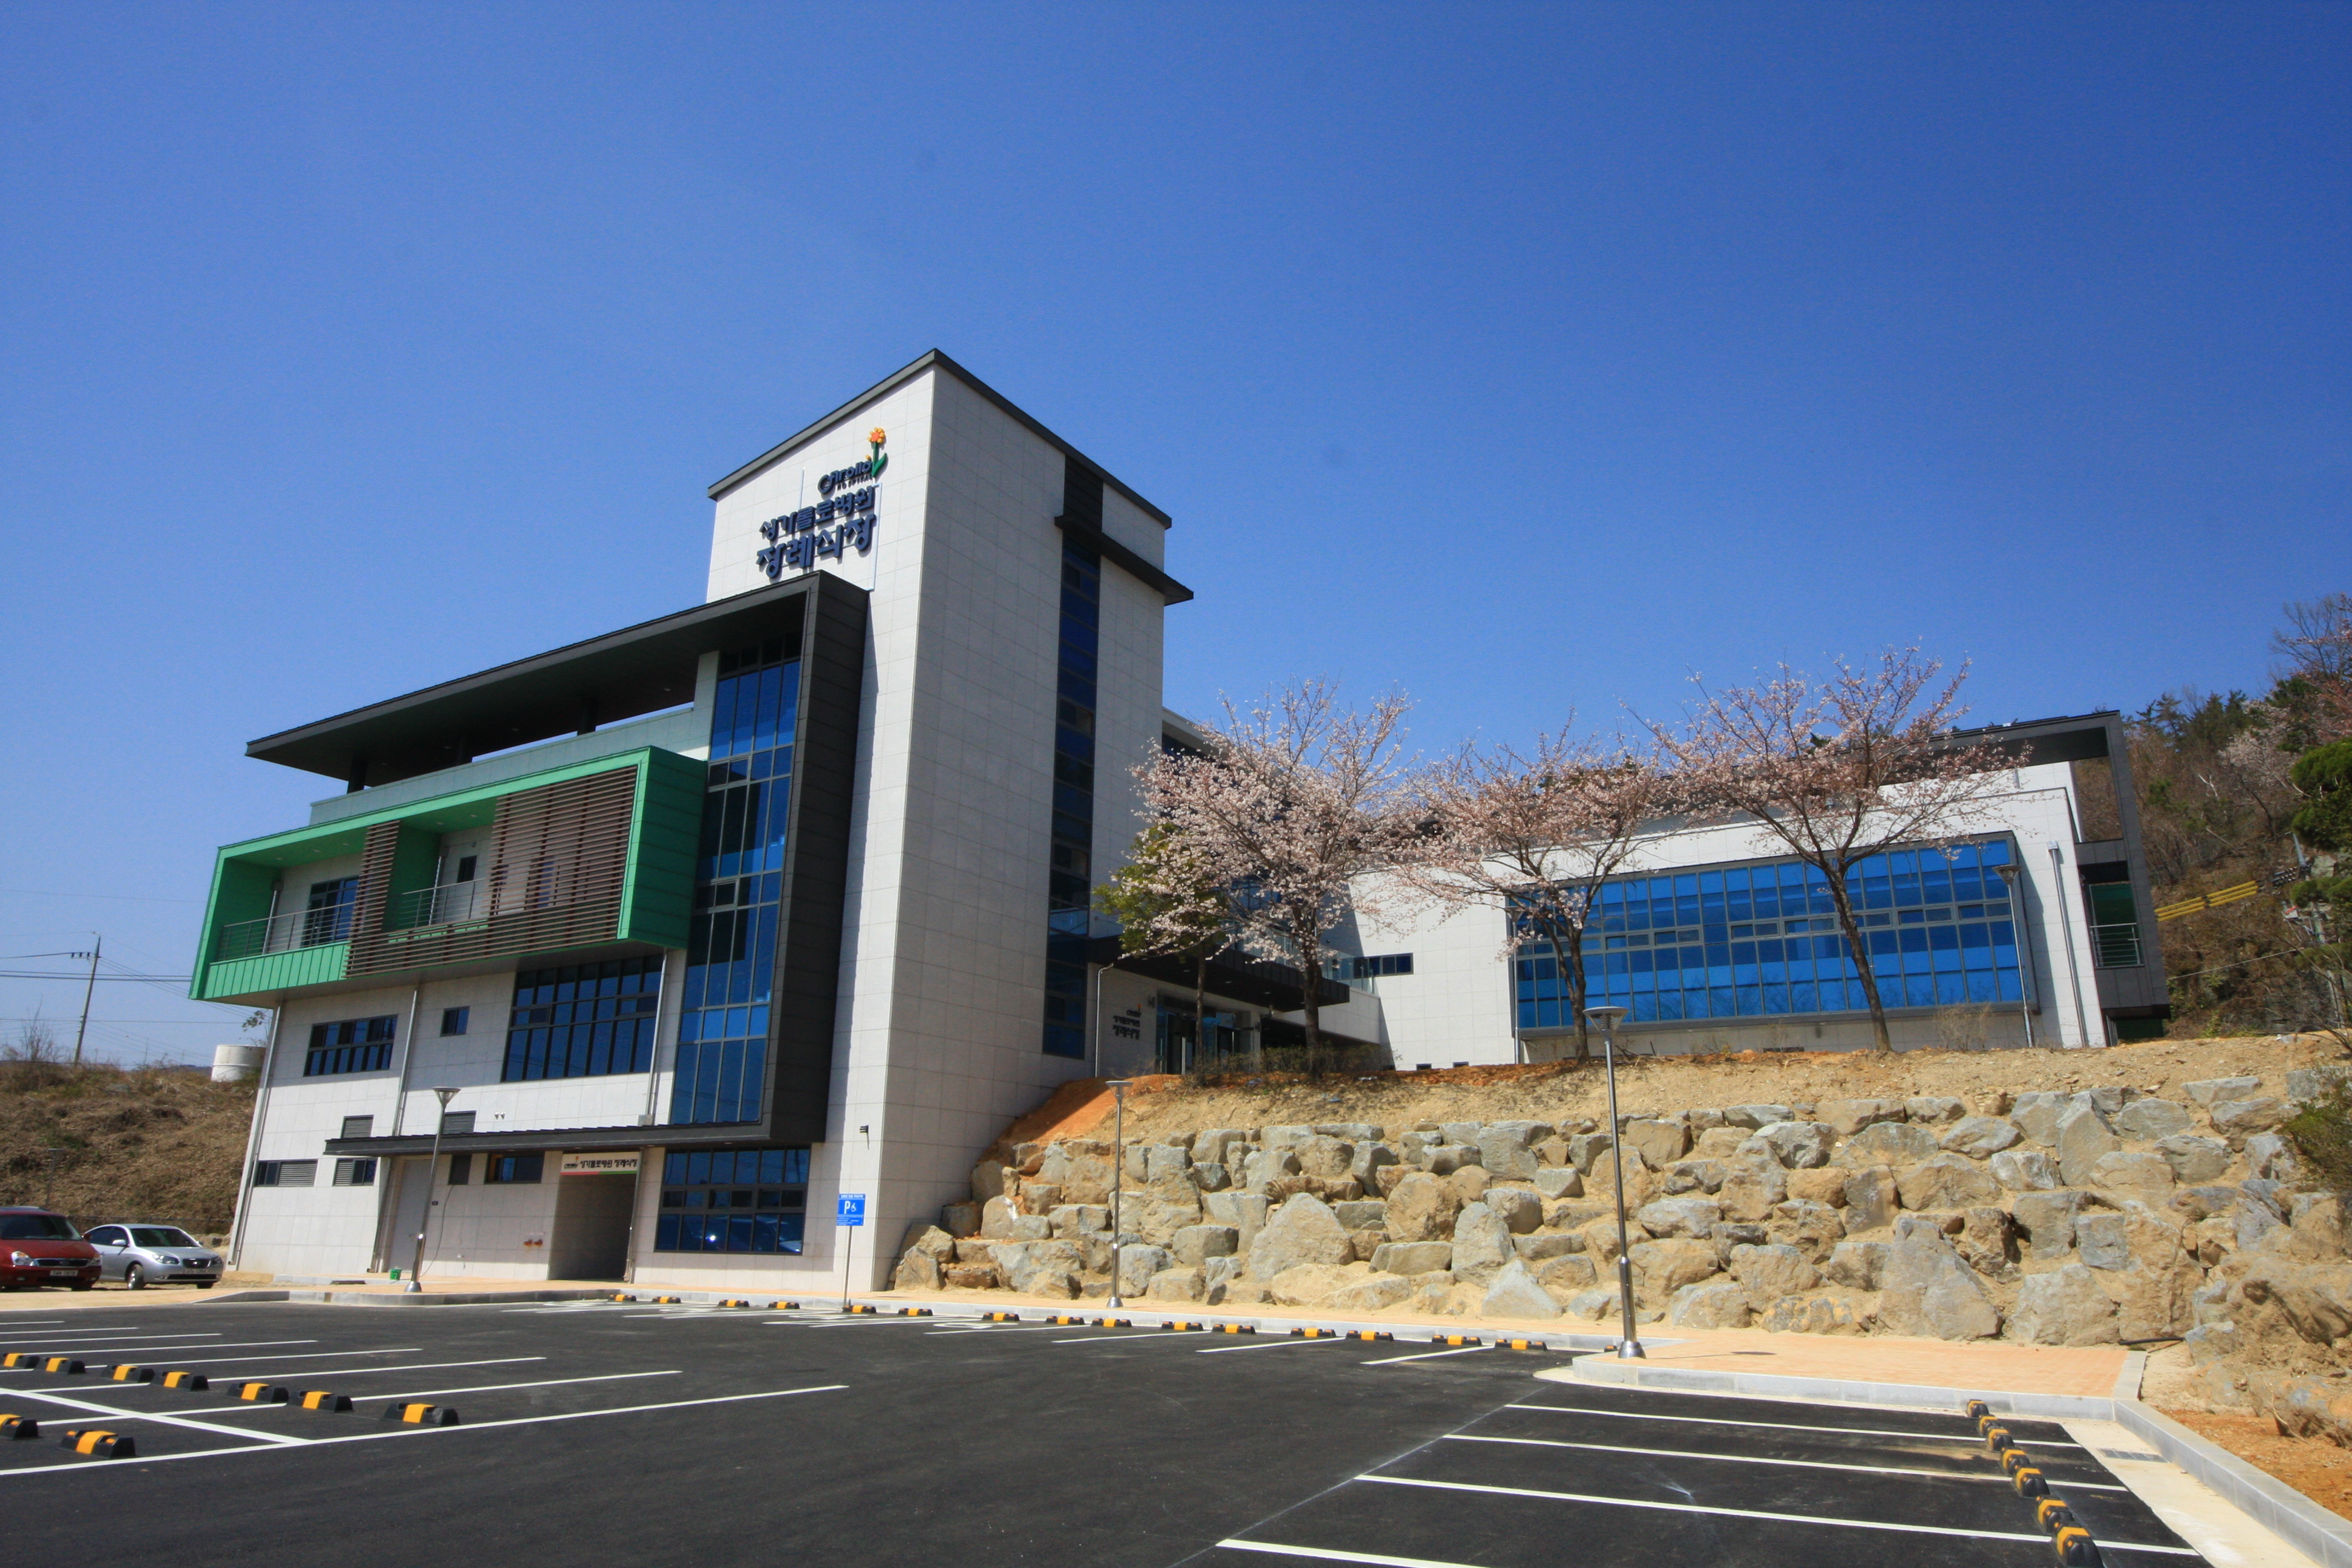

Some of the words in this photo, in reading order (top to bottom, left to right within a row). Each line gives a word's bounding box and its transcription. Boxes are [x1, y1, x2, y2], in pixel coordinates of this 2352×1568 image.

[837, 474, 873, 491] HOSPITAL
[756, 514, 877, 578] 장례식장
[844, 1200, 851, 1214] P
